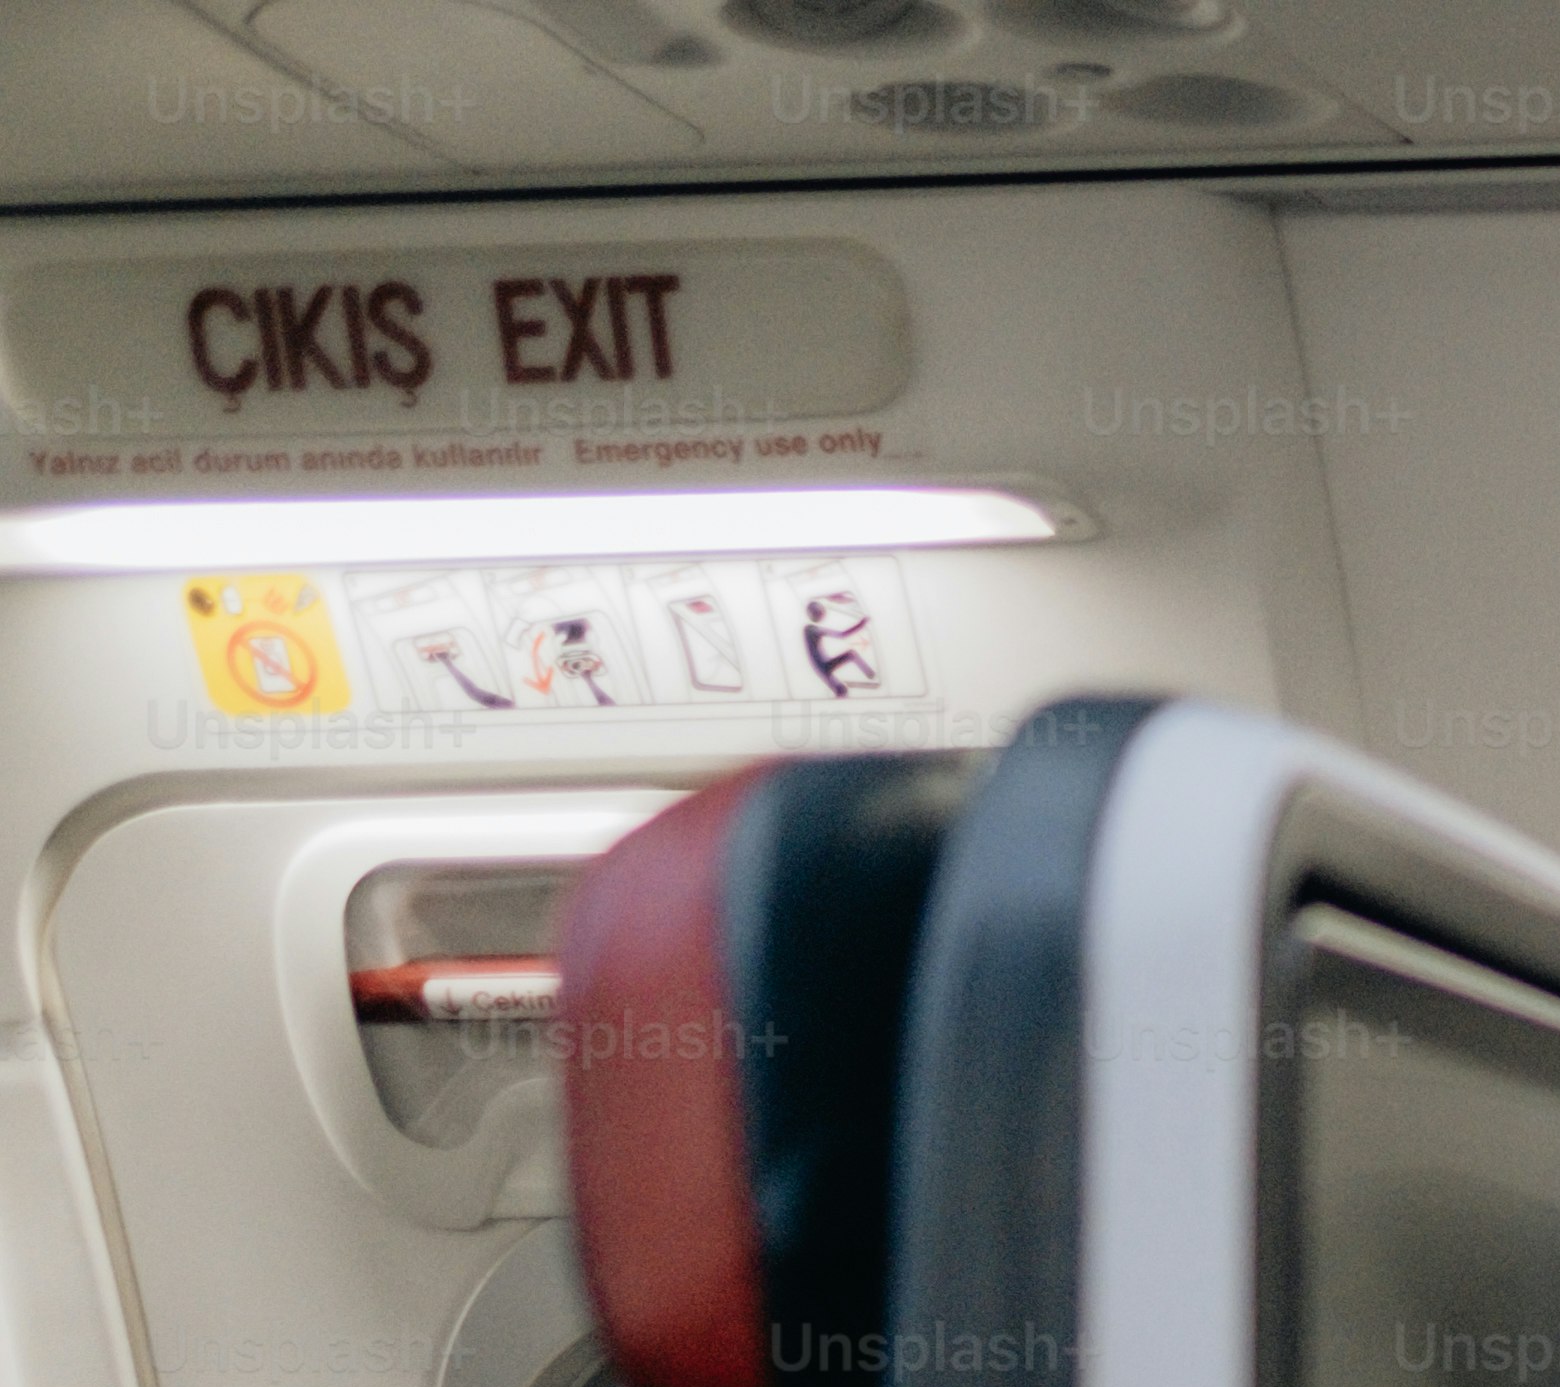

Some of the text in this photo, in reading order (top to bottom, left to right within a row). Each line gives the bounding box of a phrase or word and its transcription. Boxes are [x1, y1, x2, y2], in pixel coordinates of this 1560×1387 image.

[187, 274, 681, 413] ÇIKIŞ EXIT
[193, 447, 291, 473] durum
[573, 428, 882, 468] Emergency use only
